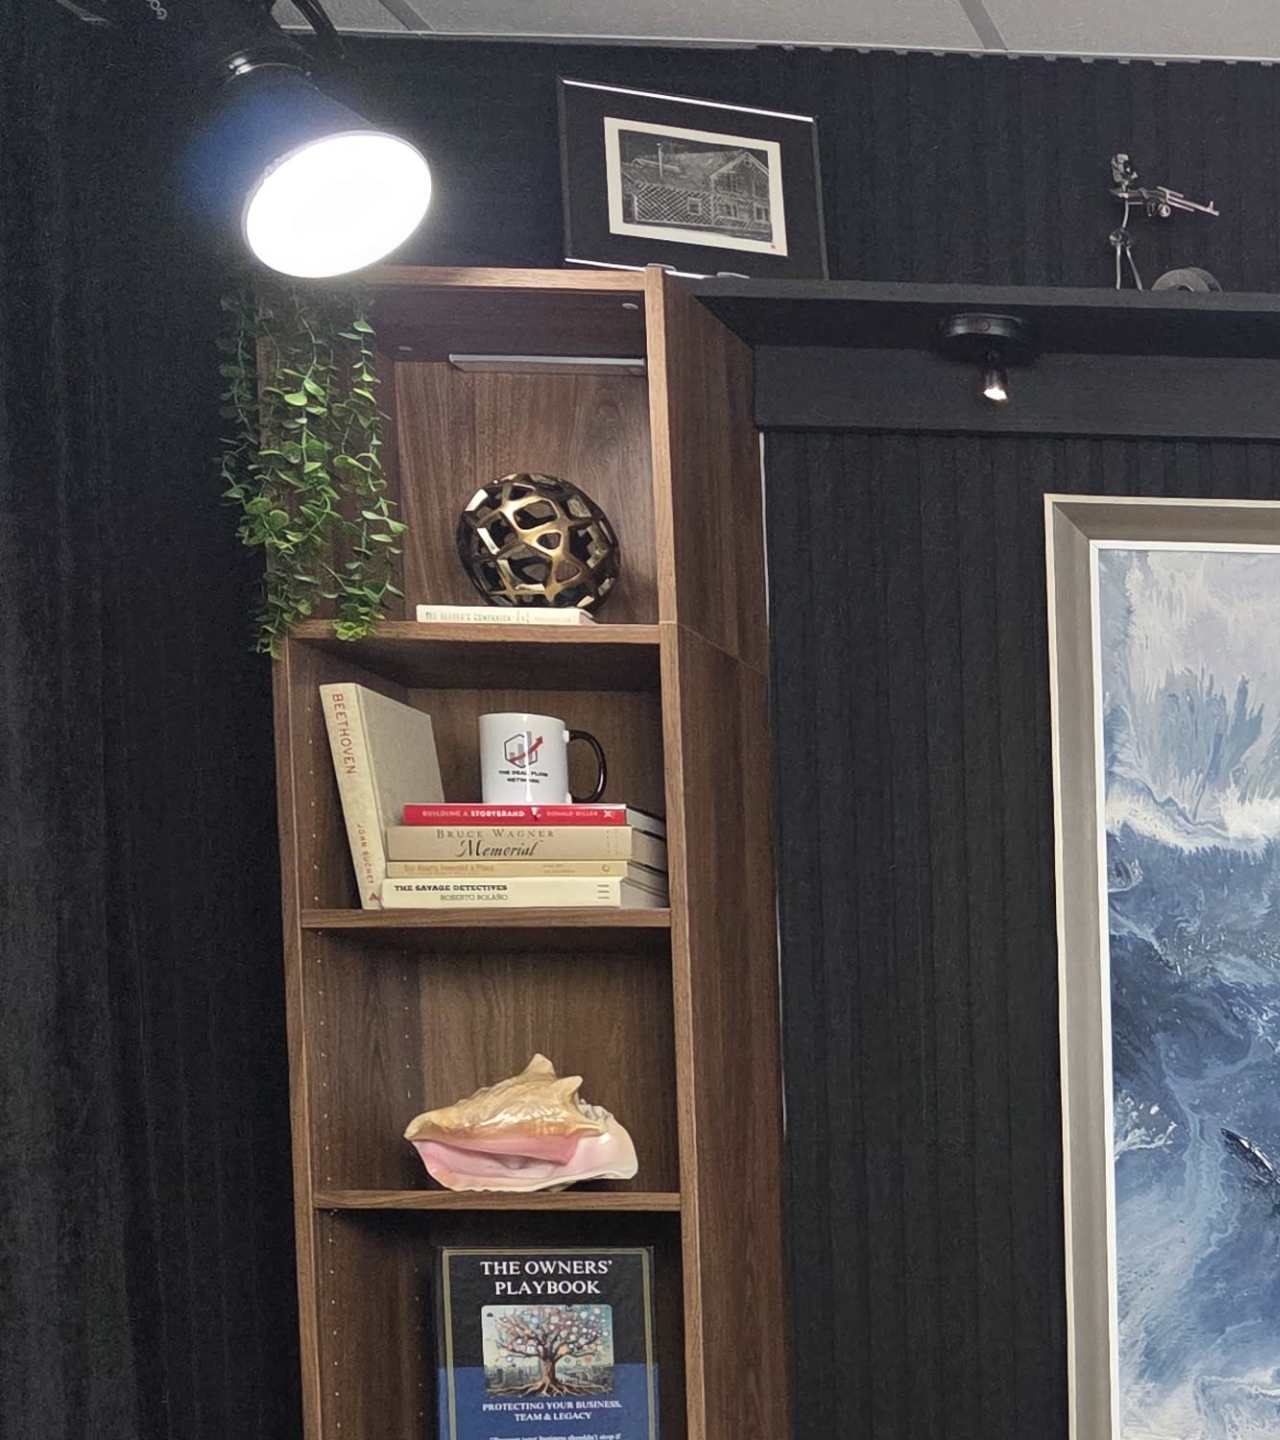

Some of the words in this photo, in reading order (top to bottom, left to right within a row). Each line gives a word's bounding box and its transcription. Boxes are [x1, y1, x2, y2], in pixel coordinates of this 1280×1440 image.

[332, 693, 356, 775] BEETHOVEN
[470, 809, 525, 818] STORYBRAND
[492, 829, 554, 839] WAGNER
[455, 839, 538, 857] Memorial
[395, 884, 413, 892] THE
[415, 884, 451, 892] SAVAGE
[453, 884, 508, 892] DETECTIVES
[480, 1261, 521, 1275] THE
[525, 1260, 613, 1275] OWNERS'
[495, 1281, 601, 1295] PLAYBOOK
[482, 1403, 544, 1411] PROTECTING
[546, 1402, 574, 1410] YOUR
[514, 1413, 542, 1421] TEAM
[553, 1412, 592, 1420] LEGACY
